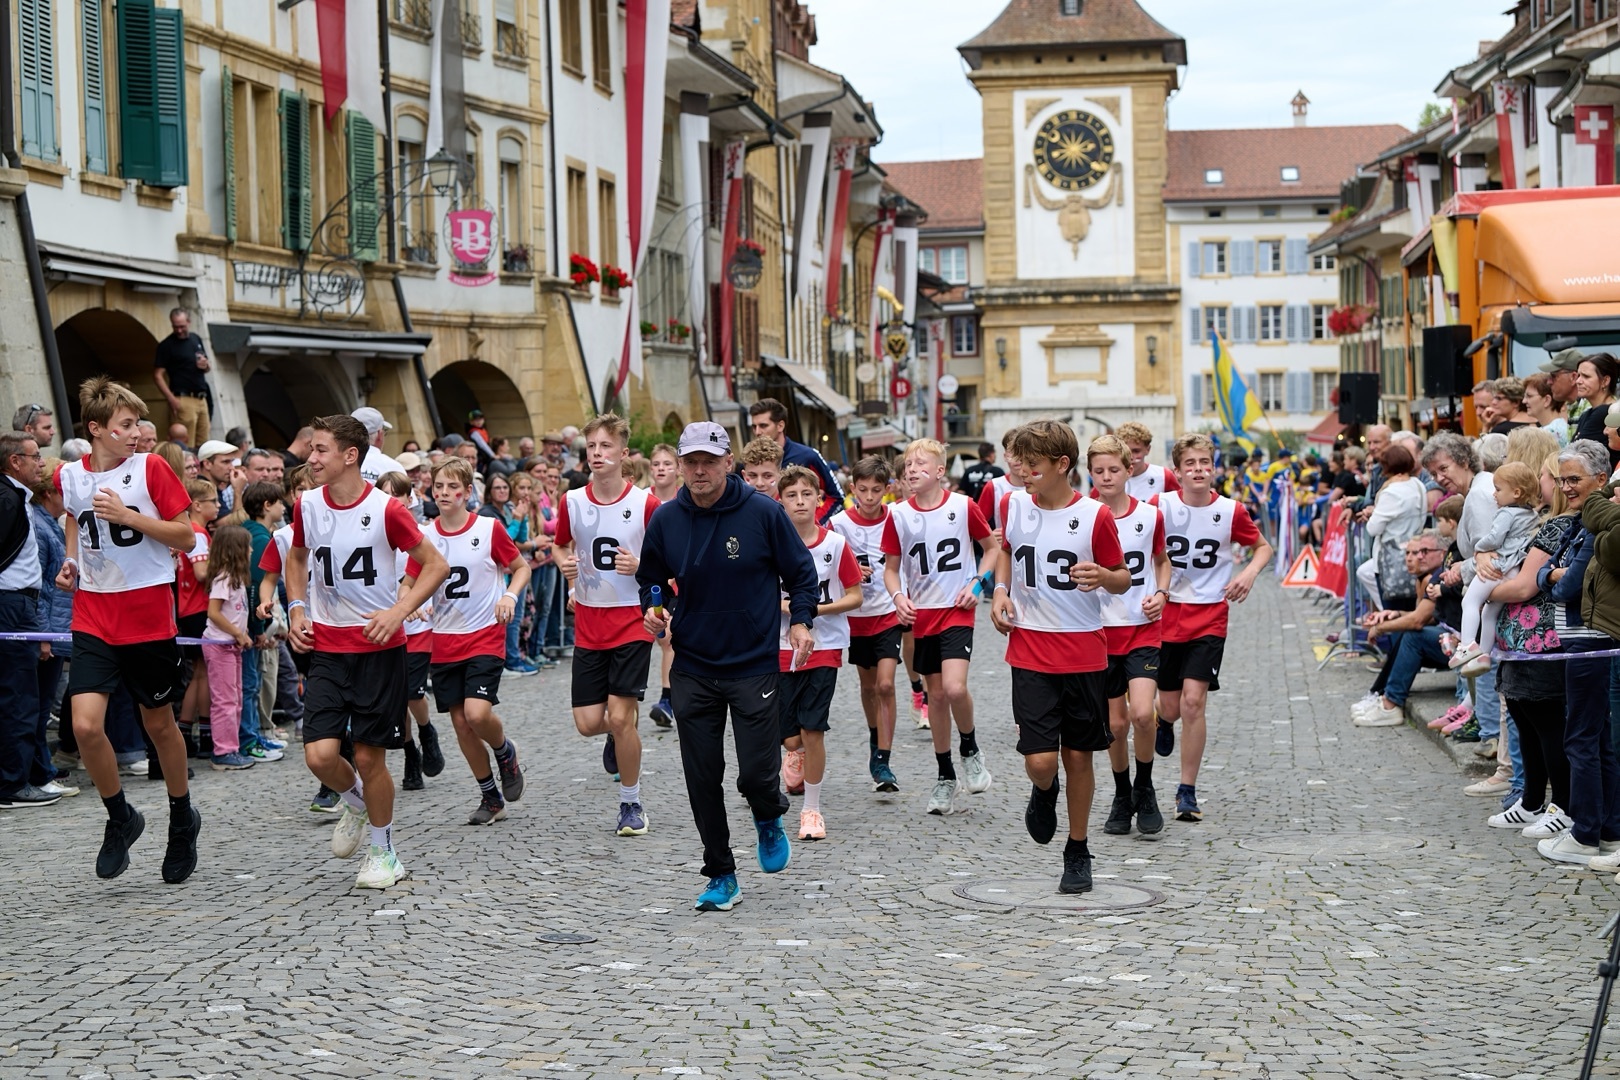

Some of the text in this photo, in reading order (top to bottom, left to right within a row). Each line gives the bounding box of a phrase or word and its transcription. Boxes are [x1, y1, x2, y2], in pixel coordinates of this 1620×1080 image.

[897, 381, 907, 395] B
[78, 505, 144, 548] 16
[314, 546, 378, 587] 14
[592, 536, 620, 571] 6
[903, 537, 962, 575] 12
[1014, 545, 1079, 591] 13
[1166, 535, 1220, 569] 23
[445, 566, 470, 599] 2
